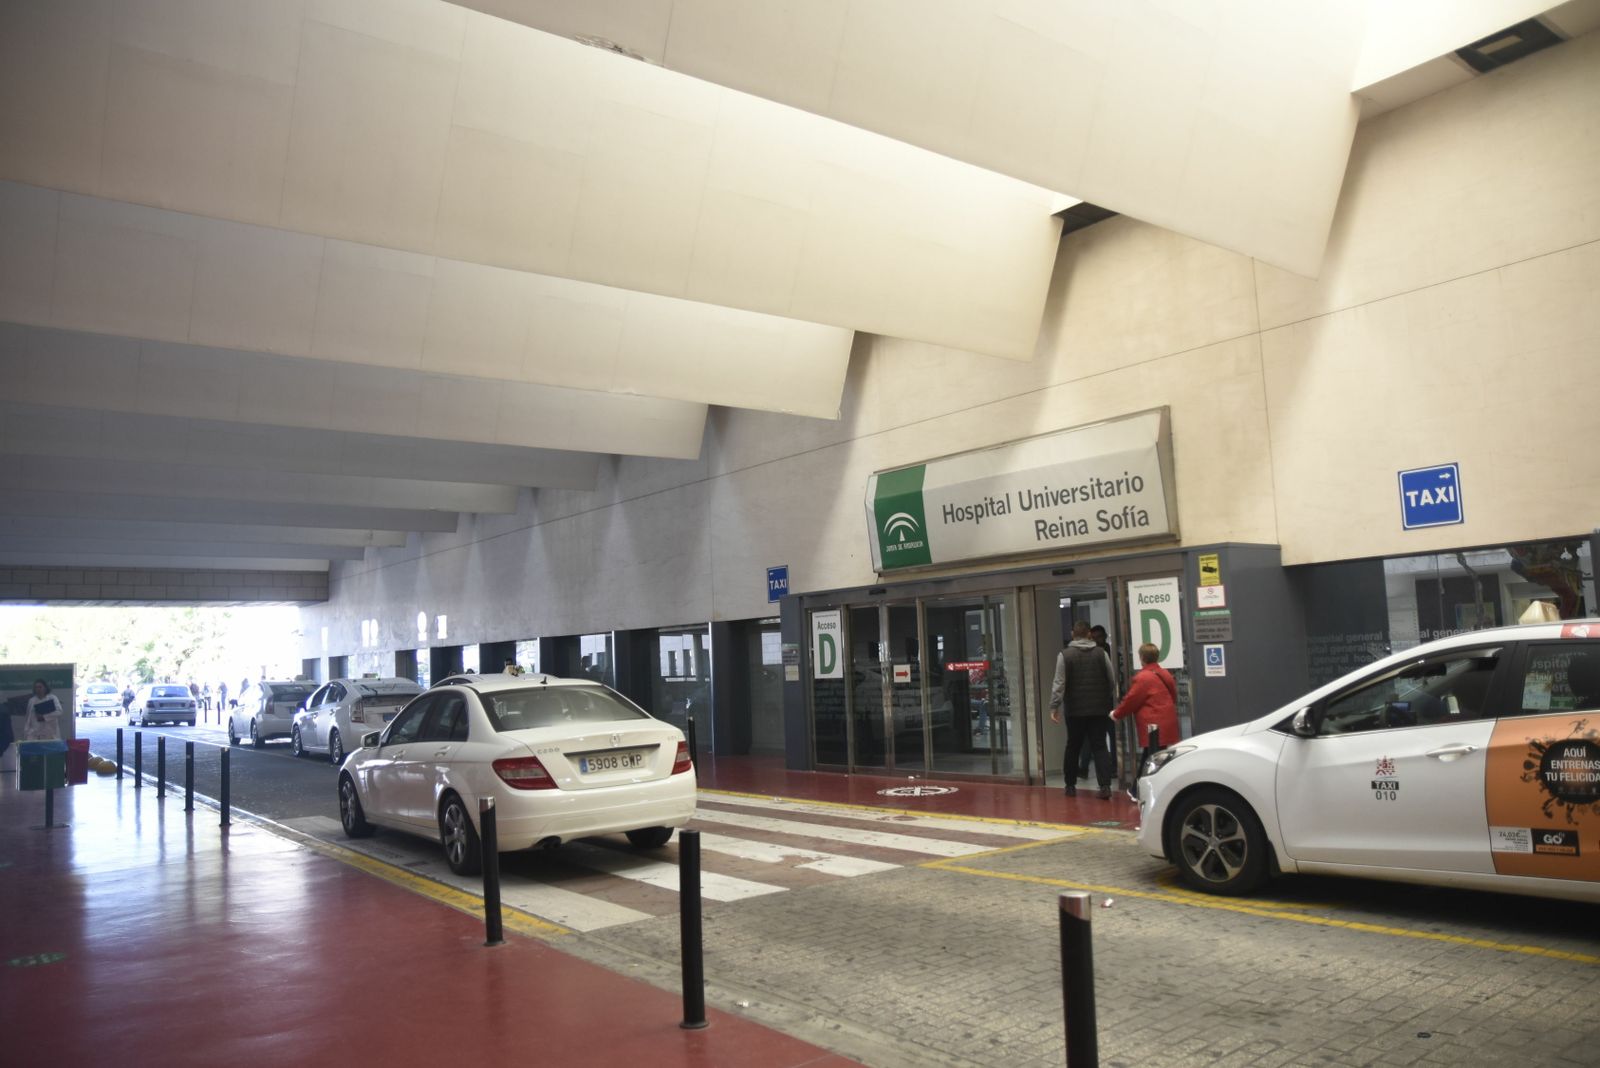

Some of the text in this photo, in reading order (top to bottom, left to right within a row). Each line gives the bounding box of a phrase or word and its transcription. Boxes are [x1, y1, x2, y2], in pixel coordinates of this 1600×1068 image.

[942, 471, 1145, 525] Hospital Universitario
[1406, 485, 1455, 507] TAXI
[1034, 505, 1150, 541] Reina Sofía
[770, 579, 787, 591] TAXI
[1138, 592, 1171, 605] Acceso
[817, 621, 837, 631] Acceso
[1140, 608, 1172, 664] D
[818, 633, 836, 674] D
[1563, 746, 1586, 758] AQUÍ
[588, 752, 642, 771] 5908 GWP
[1551, 759, 1600, 770] ENTRENAS
[1545, 771, 1558, 782] TU
[1375, 781, 1397, 790] TAXI
[1376, 791, 1397, 801] 010
[1543, 834, 1562, 845] GO
